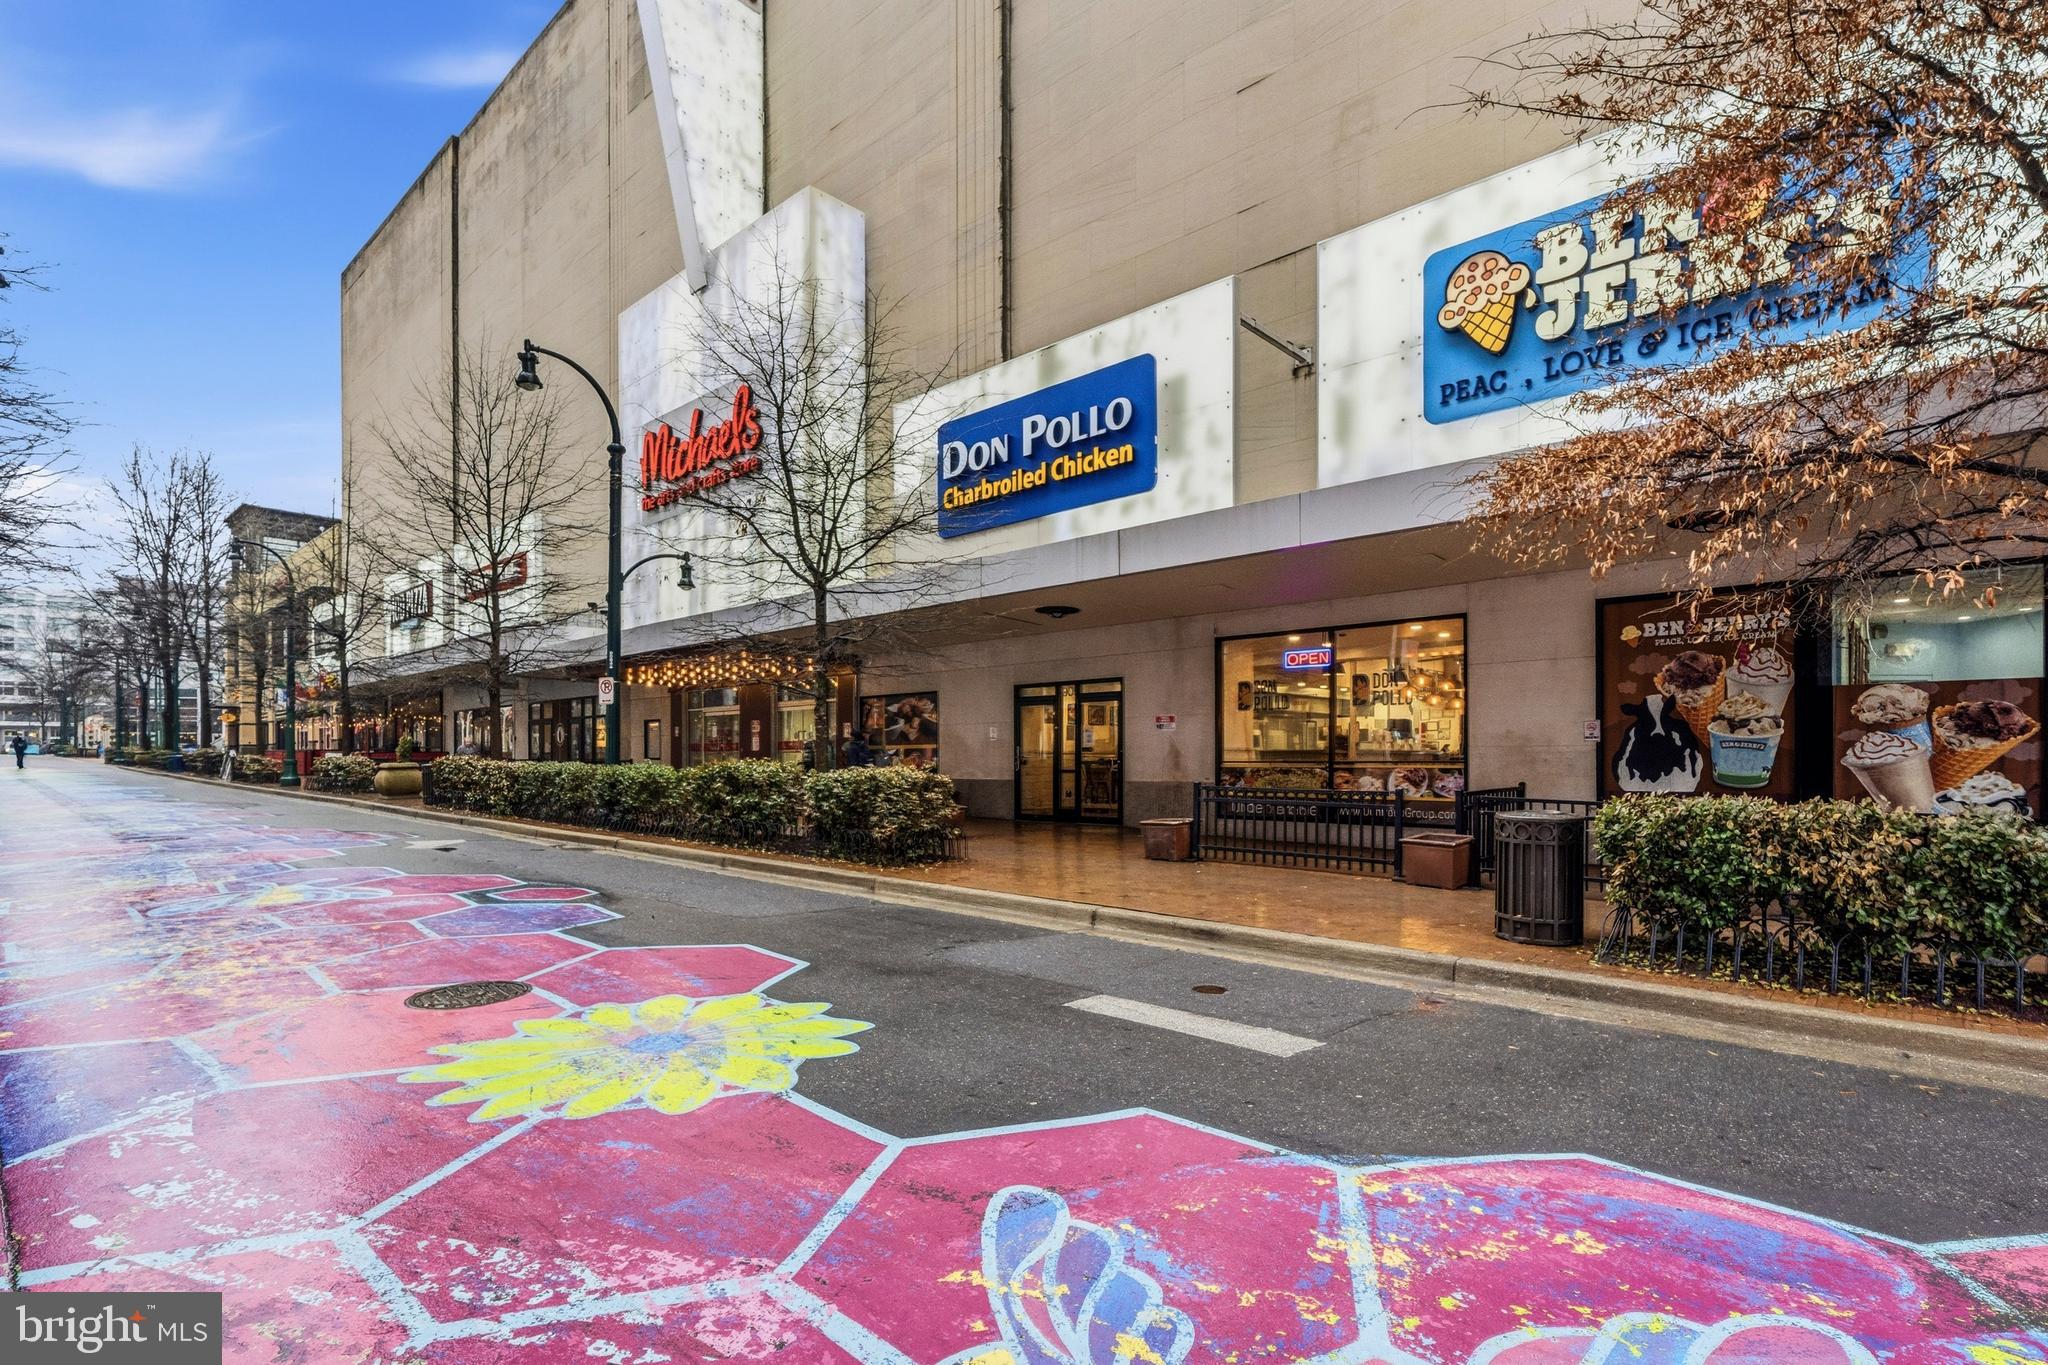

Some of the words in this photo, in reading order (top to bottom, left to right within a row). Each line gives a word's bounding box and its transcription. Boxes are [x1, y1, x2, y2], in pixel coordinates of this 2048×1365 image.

[1543, 338, 1624, 382] LOVE
[1637, 326, 1668, 358] &
[1677, 312, 1733, 350] ICE
[1749, 271, 1891, 331] CREM
[640, 384, 761, 490] Michaels
[942, 433, 1009, 480] DON
[1022, 397, 1133, 457] POLLO
[942, 461, 1047, 510] Charbroiled
[1051, 443, 1135, 482] Chicken
[1642, 620, 1685, 637] BEN
[1687, 634, 1711, 644] LOE
[1287, 651, 1330, 667] OPEN
[1373, 689, 1412, 706] POLLO
